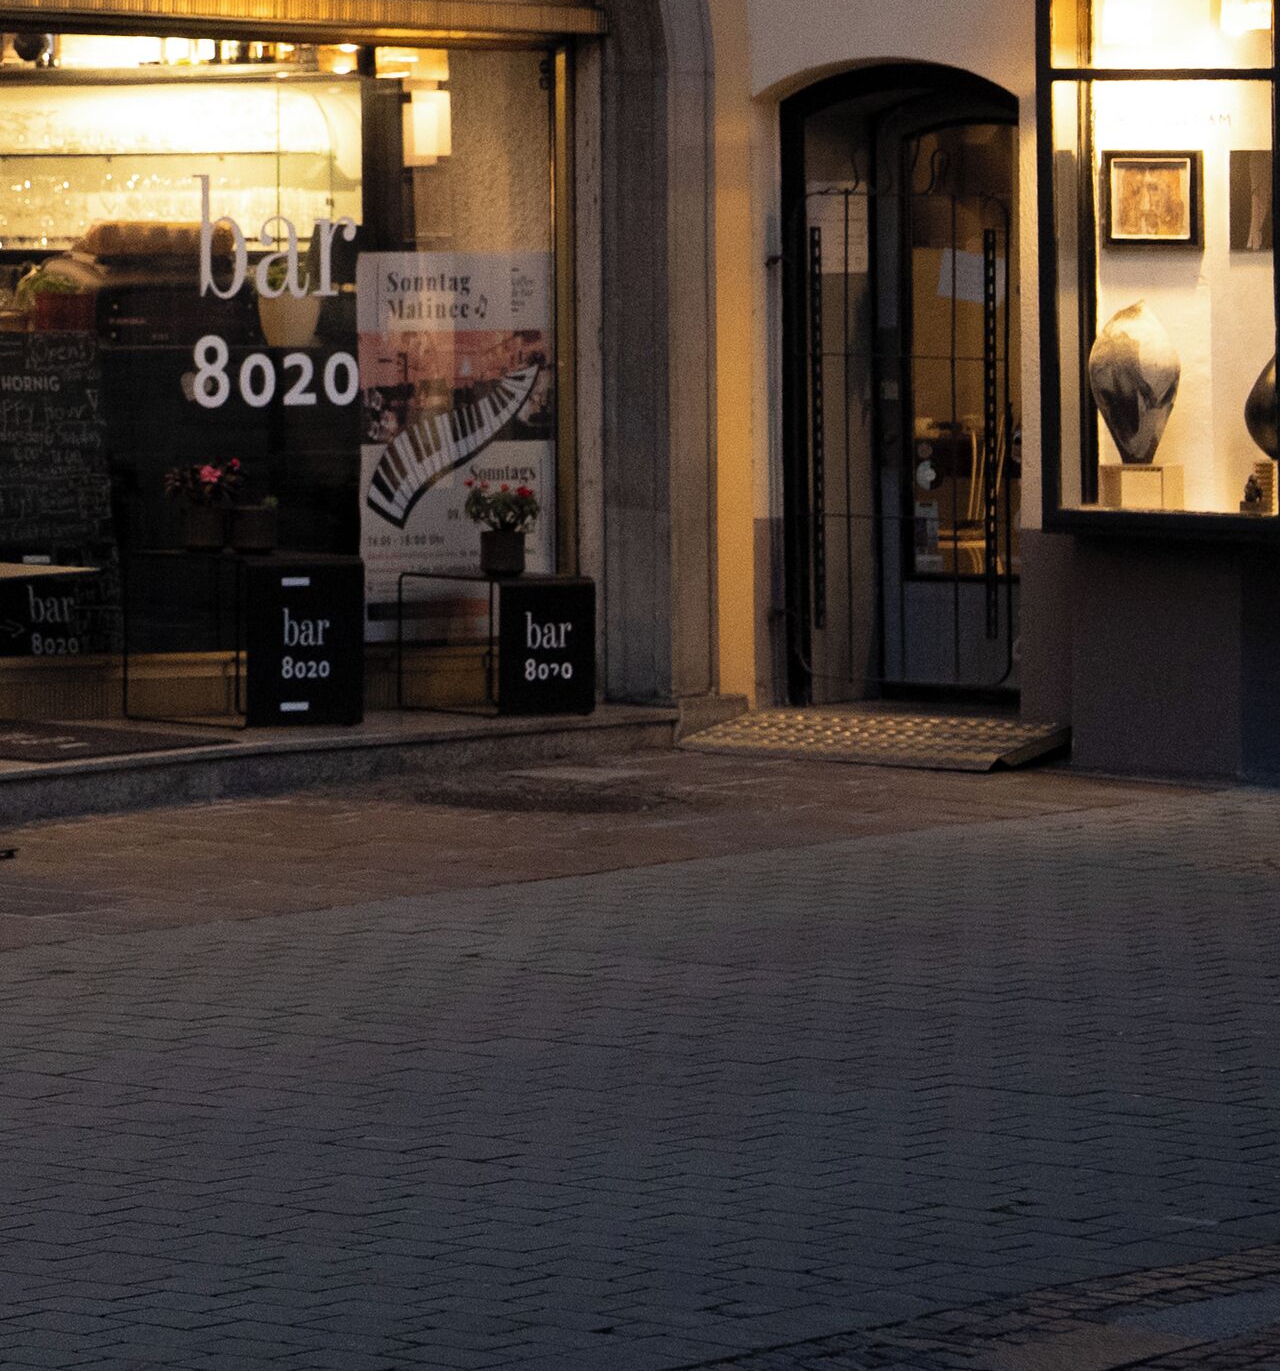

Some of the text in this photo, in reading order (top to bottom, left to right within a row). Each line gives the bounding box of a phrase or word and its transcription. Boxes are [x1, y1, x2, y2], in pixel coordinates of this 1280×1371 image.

[193, 174, 357, 300] bar
[386, 271, 472, 295] Sonntag
[1, 375, 61, 392] HORNIG
[192, 334, 360, 408] 8020
[27, 584, 75, 624] bar
[31, 631, 80, 655] 8020
[282, 607, 330, 648] bar
[525, 611, 572, 649] bar
[281, 656, 331, 680] 8020
